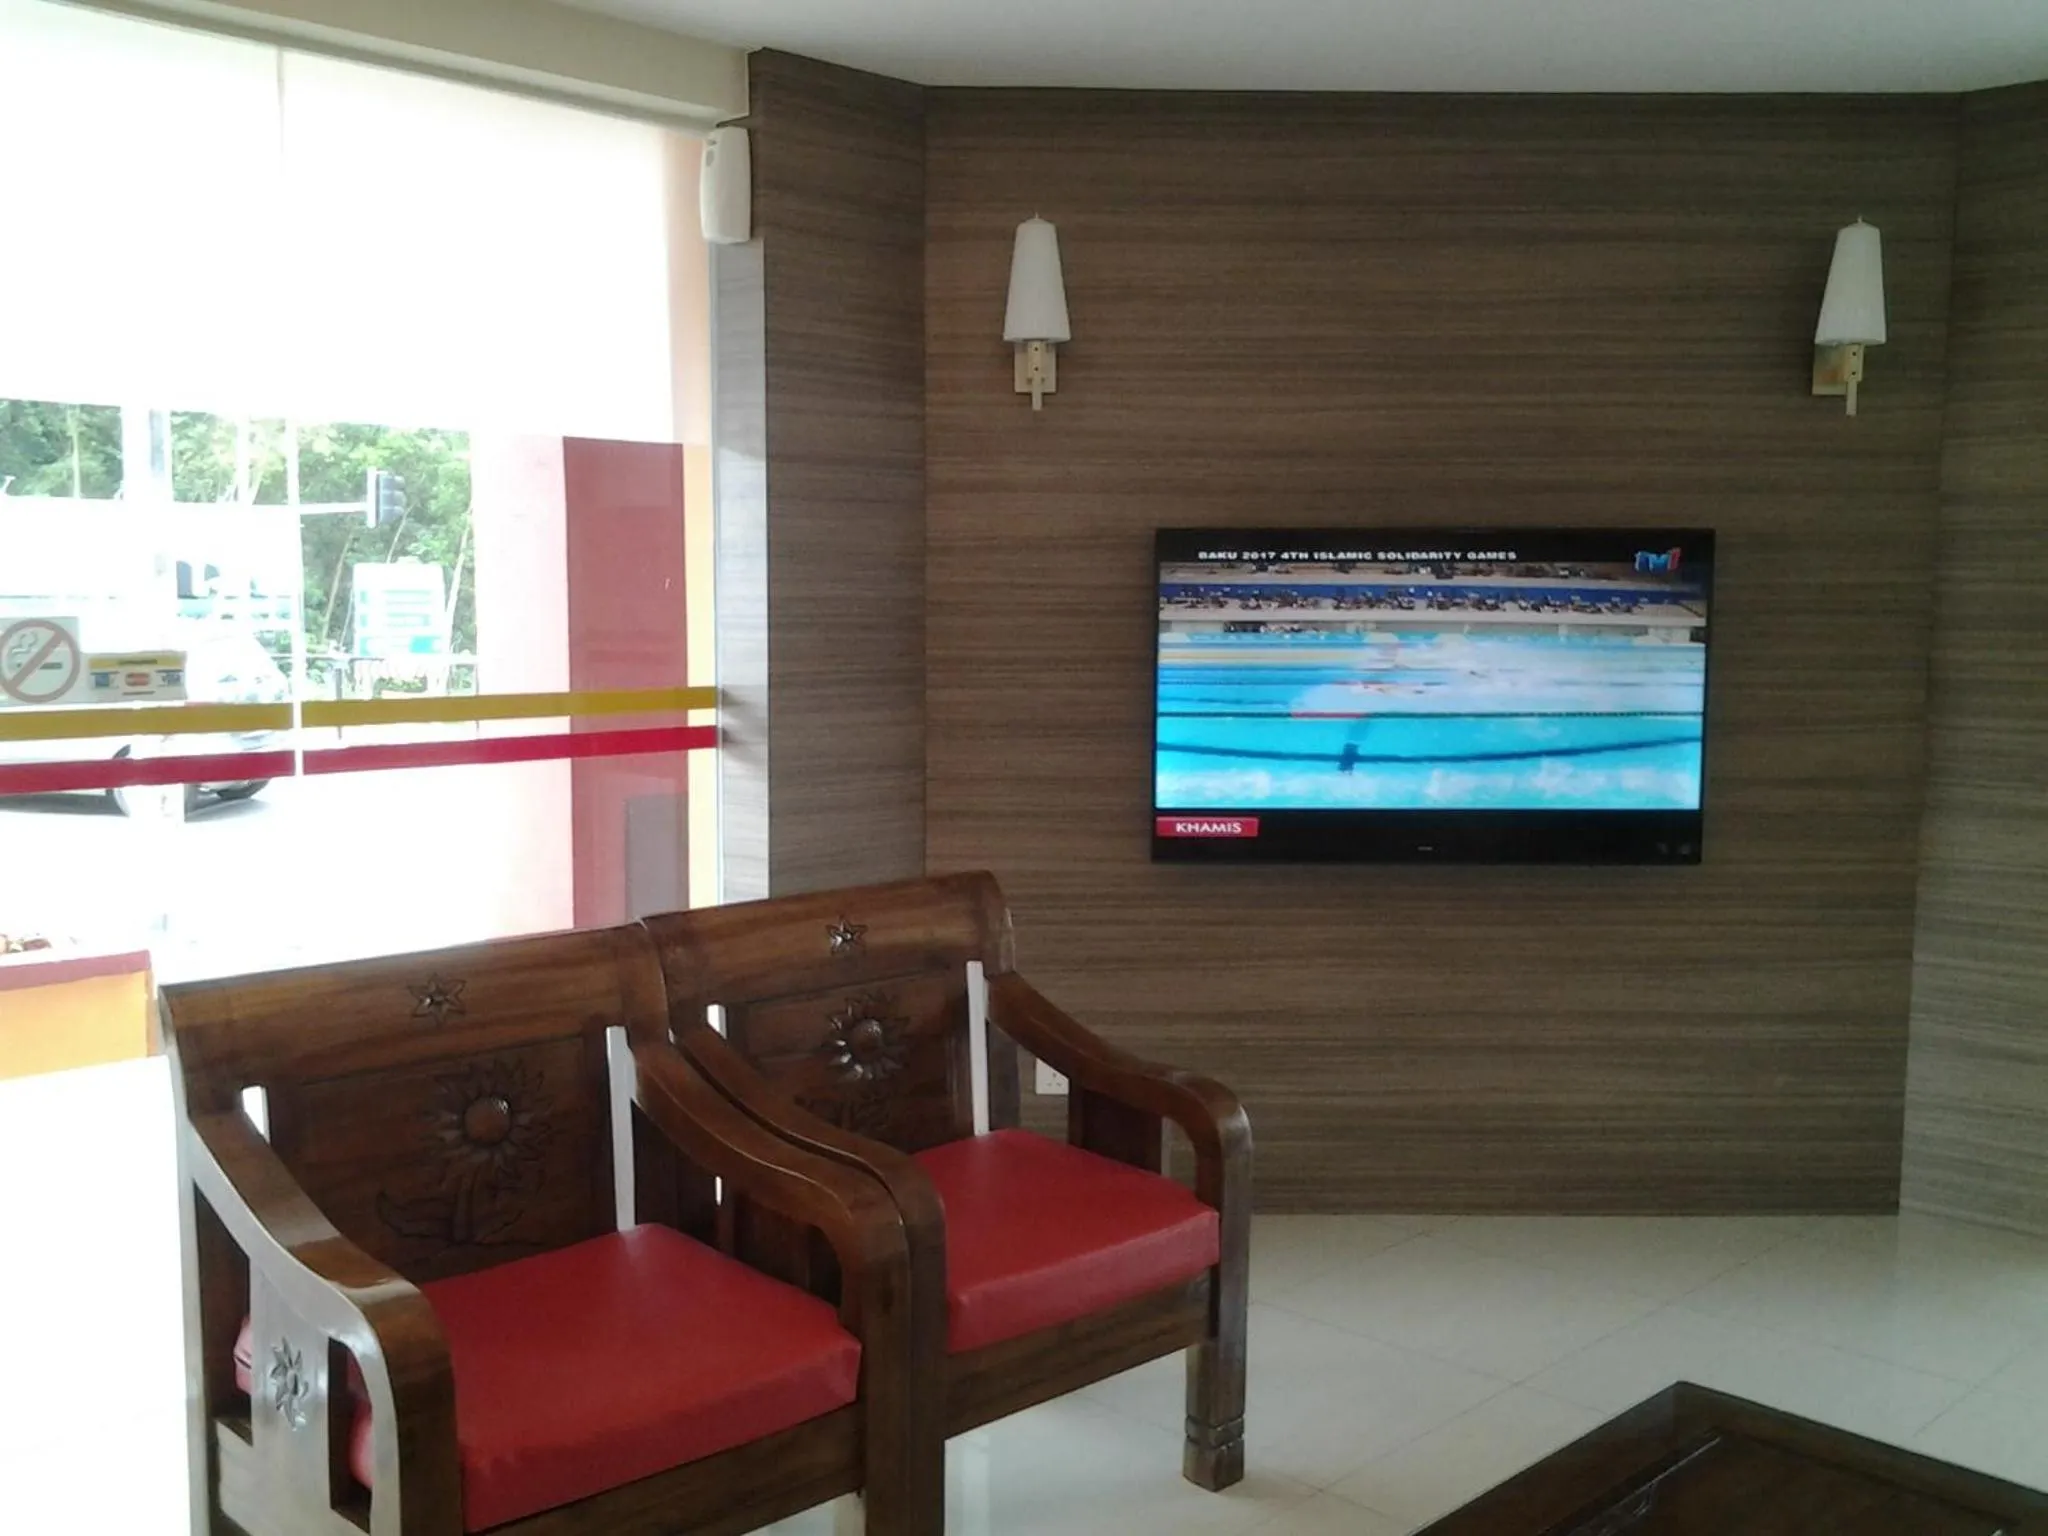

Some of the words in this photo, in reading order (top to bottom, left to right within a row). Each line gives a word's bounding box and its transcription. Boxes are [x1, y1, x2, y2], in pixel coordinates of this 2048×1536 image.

[1198, 551, 1238, 560] BAKU
[1242, 551, 1277, 560] 2017
[1280, 551, 1309, 560] 4TH
[1313, 551, 1373, 560] ISLAMIC
[1377, 551, 1463, 560] SOLIDARITY
[1466, 551, 1518, 560] GAMES
[1175, 822, 1243, 834] KHAMIS
